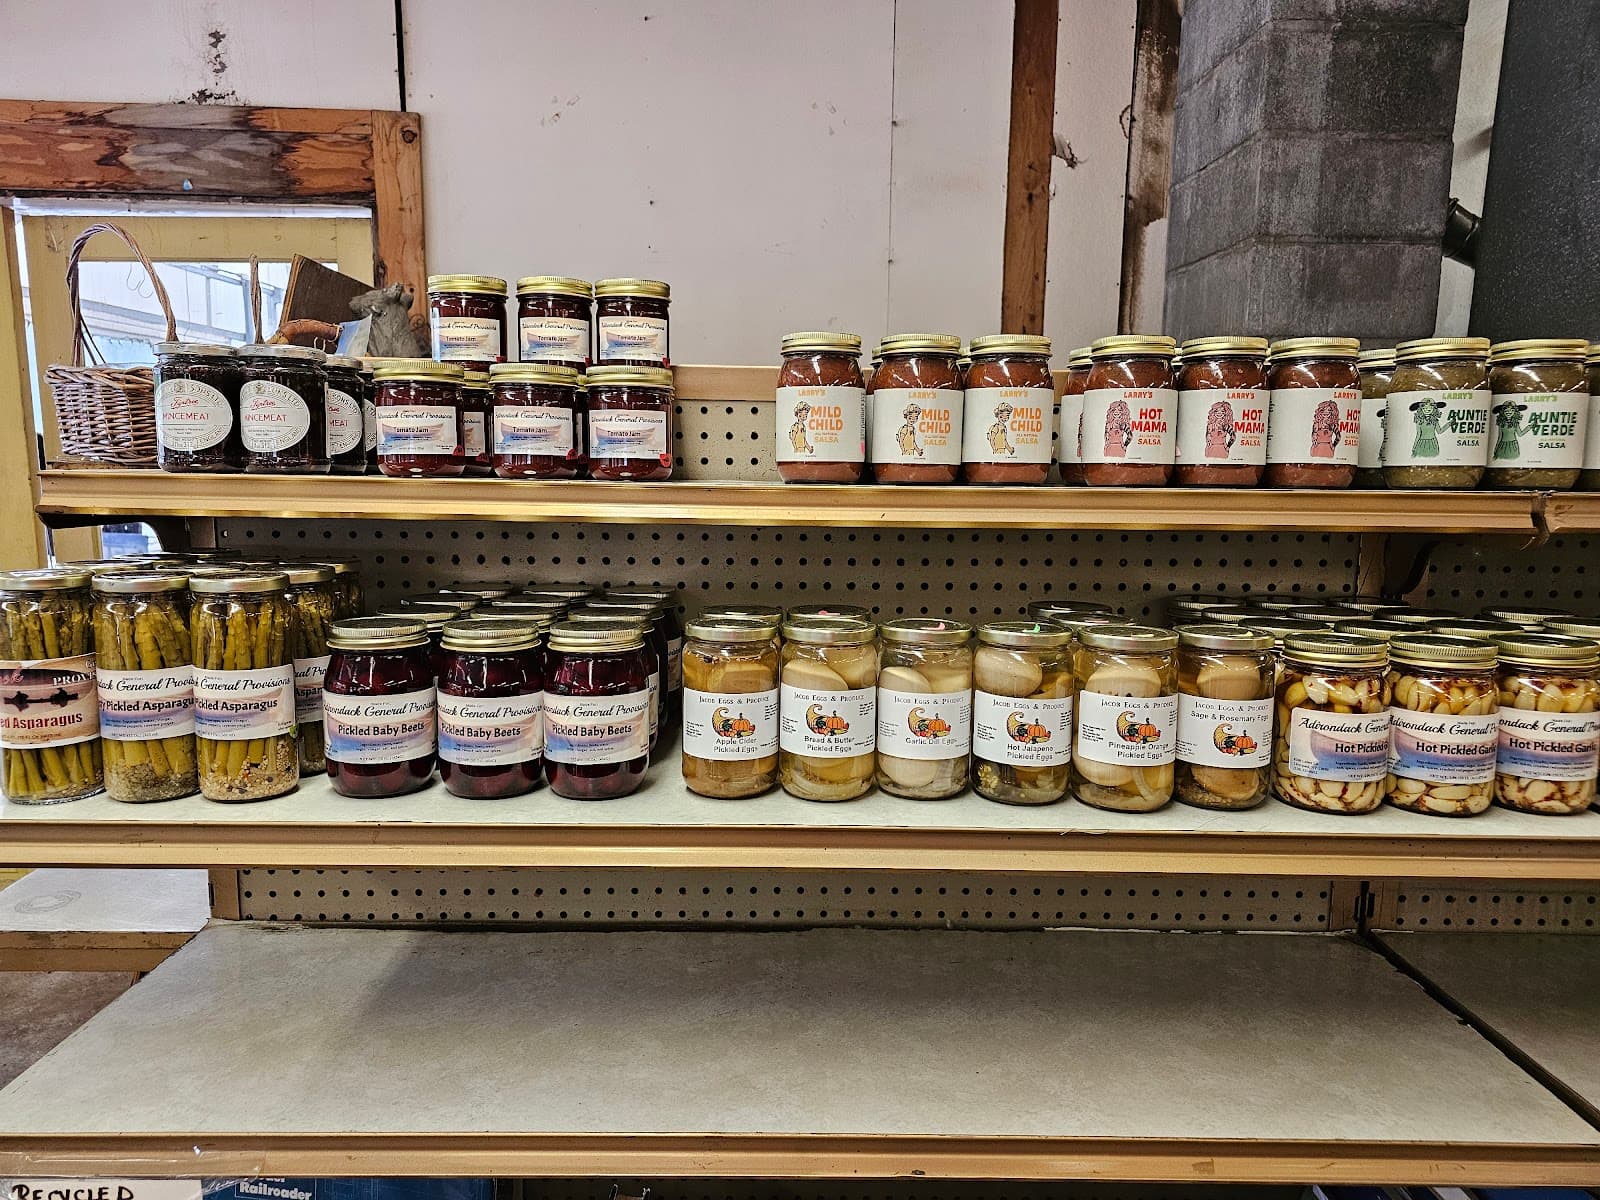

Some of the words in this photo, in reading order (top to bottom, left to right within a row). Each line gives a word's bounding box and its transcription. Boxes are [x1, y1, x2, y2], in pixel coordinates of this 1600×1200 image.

[1123, 391, 1153, 399] LARRY'S
[1227, 392, 1255, 400] LARRY'S
[810, 406, 842, 418] MILD
[921, 409, 950, 421] MILD
[1012, 407, 1042, 420] MILD
[1140, 408, 1163, 420] HOT
[1242, 409, 1263, 421] HOT
[1446, 409, 1488, 421] AUNTIE
[1527, 411, 1578, 424] AUNTIE
[808, 419, 844, 431] CHILD
[918, 422, 951, 434] CHILD
[1010, 420, 1042, 433] CHILD
[1131, 421, 1167, 433] MAMA
[1234, 421, 1265, 434] MAMA
[1450, 421, 1486, 434] VERDE
[1531, 424, 1575, 436] VERDE
[1240, 439, 1261, 447] SALSA
[1456, 439, 1480, 447] SALSA
[116, 677, 163, 691] General
[200, 679, 241, 691] General
[242, 677, 290, 690] Provisions
[106, 700, 140, 711] Pickled
[220, 699, 278, 713] Asparagus
[1101, 698, 1121, 707] JACOB
[1195, 701, 1215, 709] JACOB
[364, 703, 407, 717] General
[460, 707, 502, 718] General
[573, 705, 613, 718] General
[1190, 710, 1209, 720] Sage
[1219, 714, 1255, 722] Rosemary
[12, 712, 83, 730] Asparagus
[1298, 717, 1362, 734] Adirondack
[1543, 721, 1586, 733] General
[338, 724, 370, 736] Pickled
[372, 725, 399, 737] Baby
[401, 721, 425, 734] Beets
[441, 722, 465, 737] Pickled
[466, 727, 492, 740] Baby
[494, 727, 521, 738] Beets
[552, 725, 578, 737] Pickled
[580, 726, 606, 738] Baby
[607, 724, 632, 735] Beets
[1449, 722, 1490, 736] General
[716, 737, 737, 746] Apple
[804, 735, 825, 744] Bread
[905, 737, 927, 745] Garlic
[1509, 737, 1532, 750] Hot
[1533, 741, 1574, 753] Pickled
[807, 744, 833, 752] Pickled
[834, 745, 852, 753] Eggs
[1007, 743, 1020, 751] Hot
[1108, 741, 1146, 752] Pineapple
[1335, 743, 1355, 753] Hot
[1357, 741, 1384, 753] Pickled
[1415, 741, 1439, 753] Hot
[1439, 744, 1477, 755] Pickled
[1007, 751, 1034, 760] Pickled
[1036, 754, 1053, 762] Eggs
[1117, 751, 1145, 759] Pickled
[1147, 752, 1163, 760] Eggs
[239, 1182, 313, 1200] Railroader
